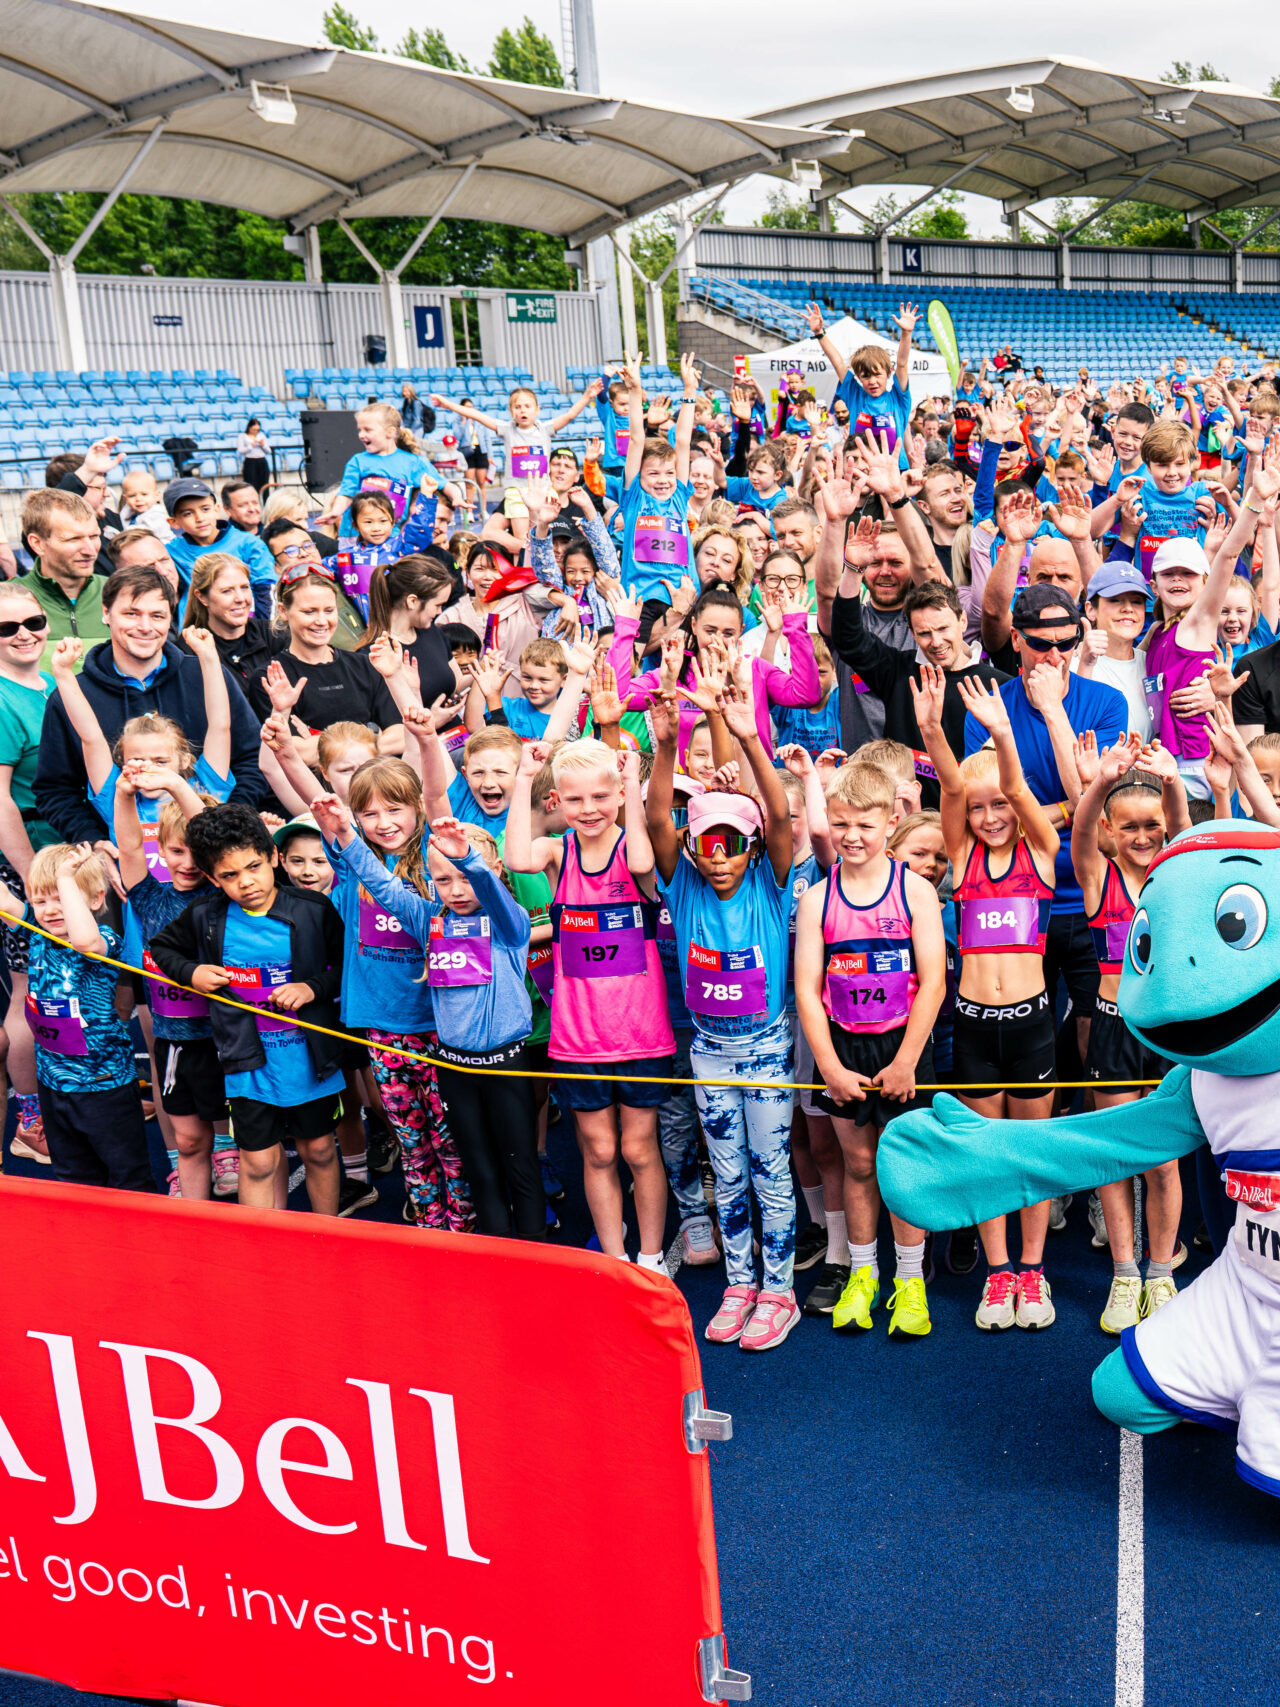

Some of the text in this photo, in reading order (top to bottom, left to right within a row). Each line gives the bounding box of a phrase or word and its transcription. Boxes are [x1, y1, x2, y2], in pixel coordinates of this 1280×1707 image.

[905, 248, 918, 267] K
[535, 298, 555, 309] FIRE
[535, 309, 555, 319] EXIT
[424, 313, 435, 341] J
[770, 360, 827, 372] FIRST AID
[912, 360, 929, 371] AID
[651, 539, 676, 552] 212
[343, 573, 359, 586] 30
[375, 914, 403, 933] 36
[570, 917, 594, 928] AJBell
[977, 911, 1017, 929] 184
[429, 951, 467, 970] 229
[581, 944, 619, 962] 197
[695, 952, 717, 965] AJBell
[840, 959, 863, 970] AJBell
[234, 974, 257, 985] AJBell
[158, 985, 194, 1002] 462
[701, 981, 743, 1001] 785
[849, 987, 887, 1005] 174
[982, 1003, 1033, 1021] PRO
[438, 1047, 505, 1066] ARMOUR
[1241, 1185, 1273, 1205] AJBell
[43, 1553, 206, 1618] good,
[223, 1572, 514, 1684] investing.
